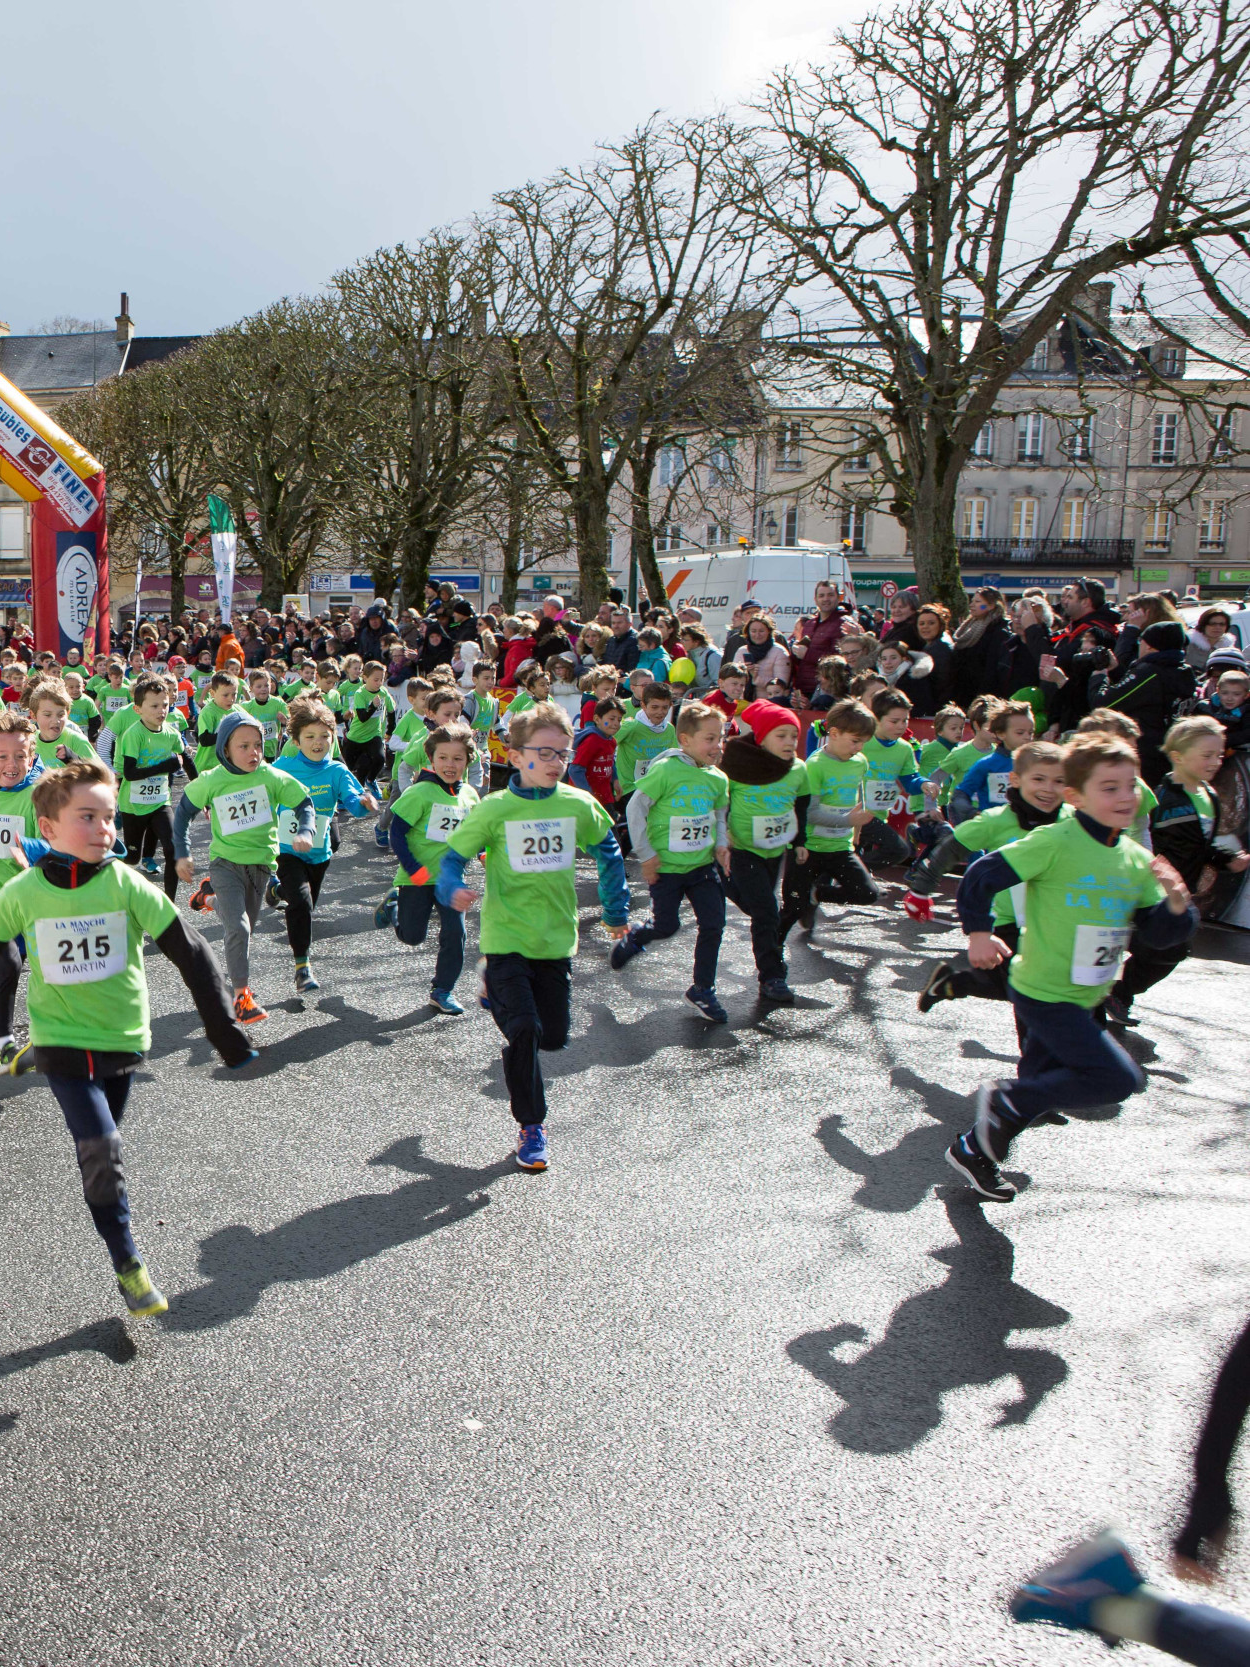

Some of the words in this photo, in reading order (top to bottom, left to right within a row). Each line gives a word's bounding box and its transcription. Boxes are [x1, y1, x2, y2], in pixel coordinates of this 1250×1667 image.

[54, 463, 92, 512] FINEL
[46, 484, 75, 513] BAYEUX
[76, 567, 88, 635] ADREA
[677, 595, 728, 609] EXAEQUO
[139, 785, 161, 795] 295
[233, 790, 254, 800] MANCHE
[874, 791, 897, 801] 222
[228, 800, 257, 820] 217
[671, 798, 686, 808] LA
[237, 816, 256, 826] FELIX
[439, 818, 463, 830] 27
[681, 826, 709, 840] 279
[523, 835, 564, 855] 203
[521, 855, 563, 866] LEANDRE
[1066, 894, 1090, 908] LA
[70, 918, 106, 928] MANCHE
[58, 935, 110, 962] 215
[62, 960, 106, 974] MARTIN
